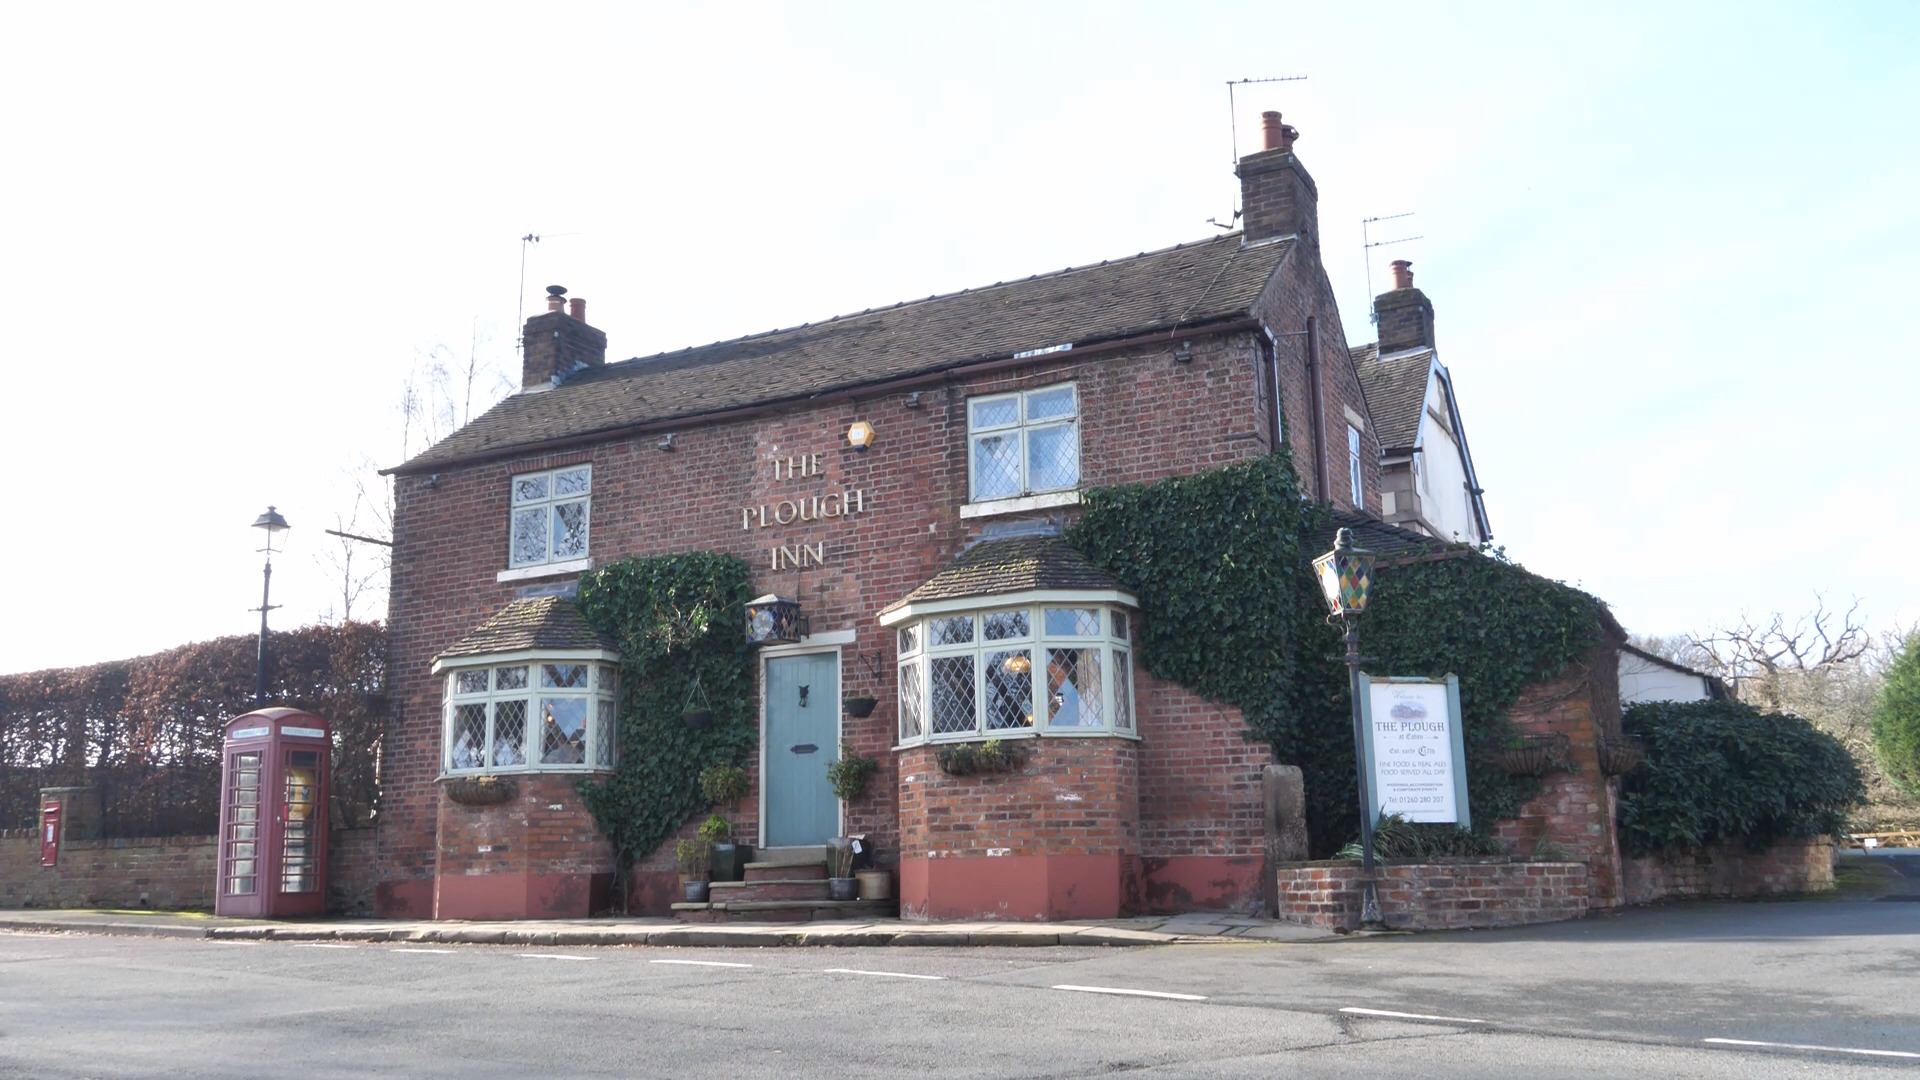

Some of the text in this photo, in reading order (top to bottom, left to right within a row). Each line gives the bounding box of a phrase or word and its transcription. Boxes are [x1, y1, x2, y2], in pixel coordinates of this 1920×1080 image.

[771, 453, 825, 482] THE
[743, 489, 864, 530] PLOUGH
[771, 541, 824, 571] INN
[1375, 721, 1445, 732] THE PLOUGH
